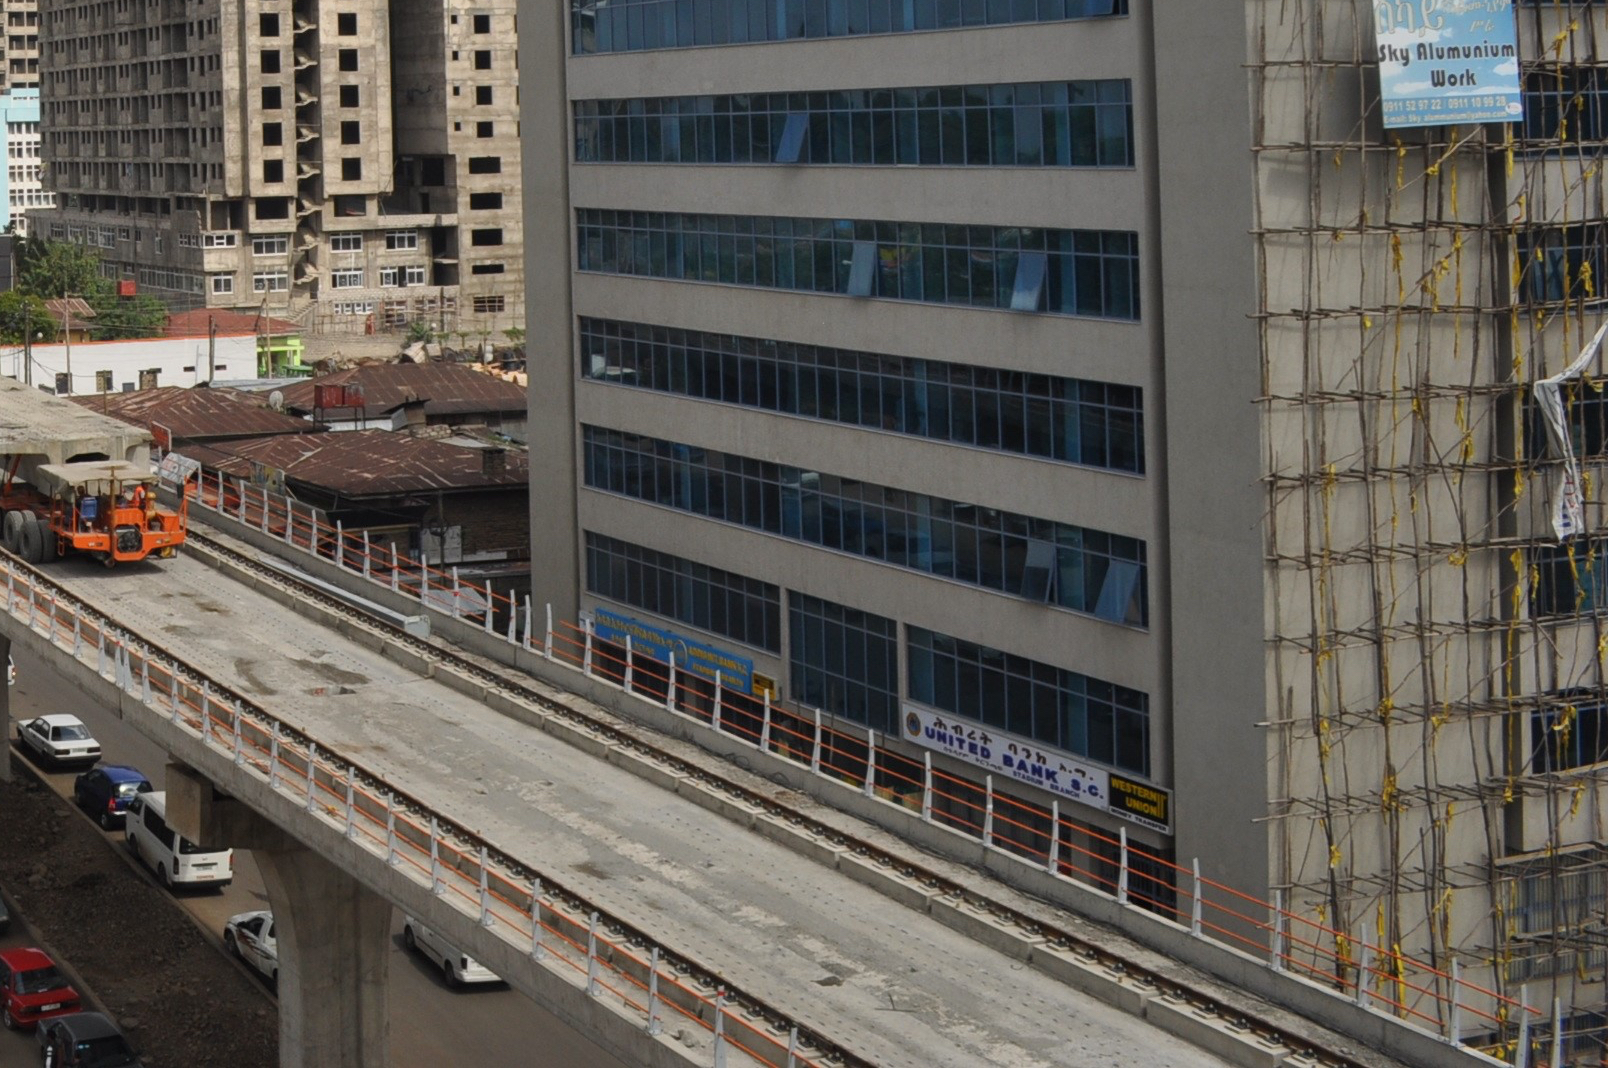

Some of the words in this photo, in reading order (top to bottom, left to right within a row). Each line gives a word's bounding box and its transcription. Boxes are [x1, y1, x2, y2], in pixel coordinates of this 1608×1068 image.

[1379, 44, 1410, 67] Sky
[1417, 40, 1515, 61] Alumunium
[1431, 69, 1477, 88] Work
[924, 726, 992, 760] UNITED
[1002, 754, 1059, 784] BANK
[1070, 778, 1104, 800] S.C.
[1008, 742, 1047, 766] ባንክ
[1012, 770, 1044, 787] STADIUM
[1050, 783, 1081, 800] BRANCH
[1111, 777, 1157, 802] WESTERN
[1125, 796, 1158, 816] UNION
[1134, 816, 1168, 832] TRANSFER
